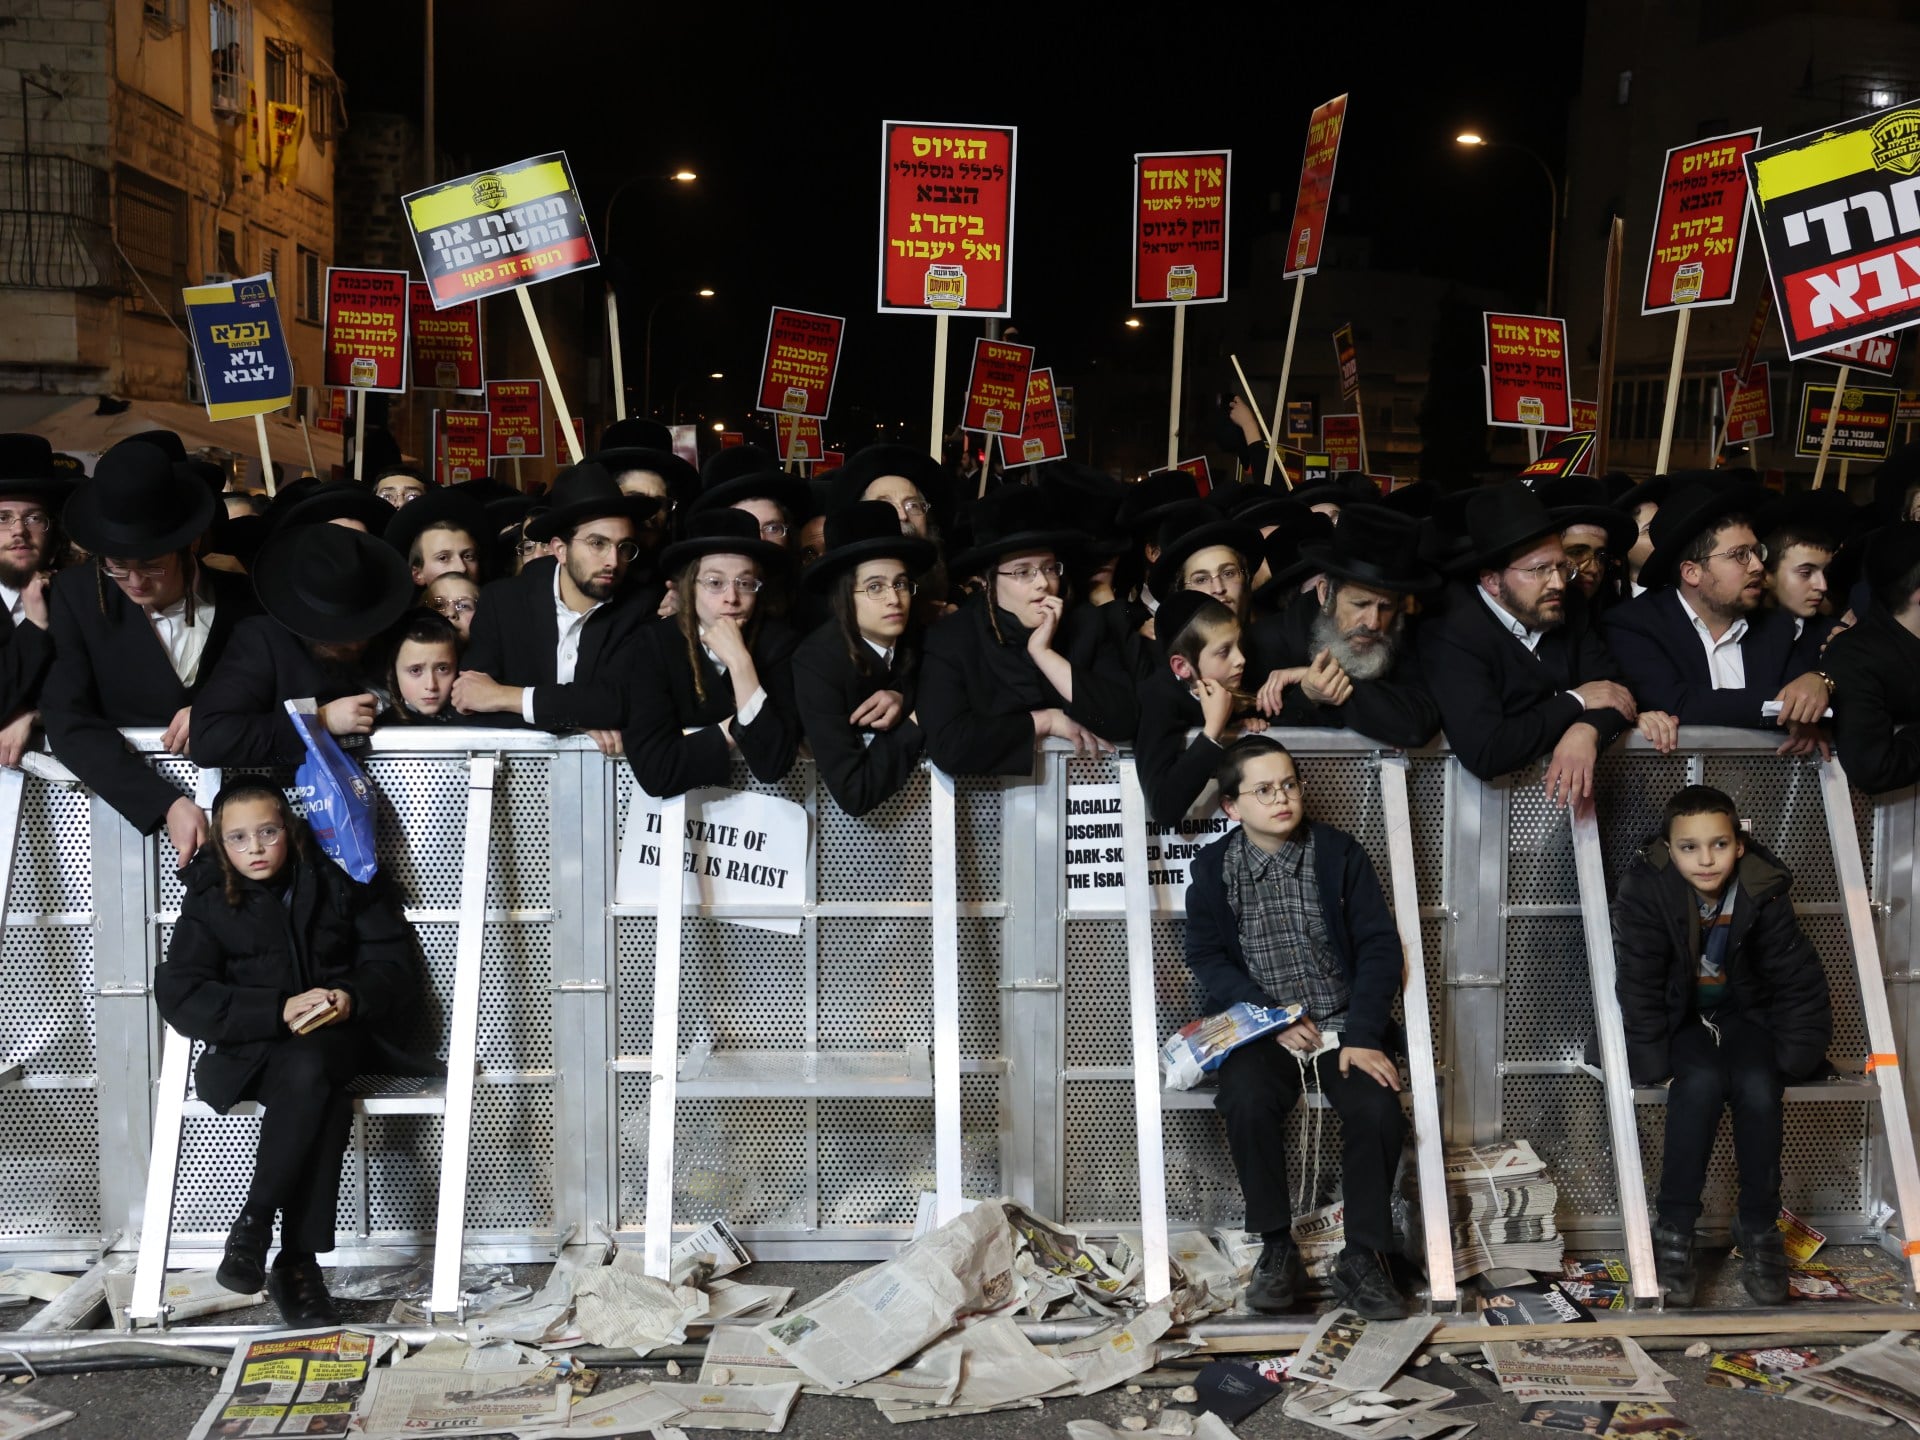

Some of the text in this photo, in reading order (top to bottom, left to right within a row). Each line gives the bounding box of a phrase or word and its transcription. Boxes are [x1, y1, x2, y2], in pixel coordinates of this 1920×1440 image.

[912, 136, 987, 160] הגיוס
[1682, 147, 1736, 174] הגיוס
[894, 160, 1004, 181] לכלל מסלולי
[1712, 169, 1745, 184] לכלל
[1144, 167, 1222, 193] אין אחד
[917, 184, 979, 204] הצבא
[1143, 194, 1220, 211] שיכול לאשר
[1679, 189, 1724, 213] הצבא
[478, 196, 568, 237] תחזירו
[910, 212, 985, 236] ביהרג
[430, 222, 474, 251] את
[1142, 217, 1220, 239] חוק לגיוס
[1670, 215, 1724, 241] ביהרג
[441, 218, 570, 270] החטופים!
[891, 238, 1001, 262] ואל יעבור
[1656, 237, 1734, 264] ואל יעבור
[461, 249, 563, 288] רוסיה זה כאן!
[337, 276, 394, 290] הסכמה
[337, 310, 395, 327] הסכמה
[419, 319, 470, 333] הסכמה
[215, 321, 267, 341] לכלא
[333, 327, 398, 342] להחרבת
[1492, 322, 1560, 346] אין אחד
[230, 349, 264, 366] ולא
[334, 342, 396, 358] היהדות
[778, 344, 828, 363] הסכמה
[988, 346, 1021, 362] הגיוס
[1493, 344, 1560, 359] שיכול לאשר
[1865, 339, 1892, 365] או
[223, 364, 275, 383] לצבא
[771, 359, 829, 377] להחרבת
[771, 372, 825, 390] היהדות
[497, 385, 530, 396] הגיוס
[982, 383, 1015, 398] ביהרג
[972, 394, 1021, 411] ואל יעבור
[446, 415, 479, 426] הגיוס
[1860, 414, 1886, 425] עברנו
[492, 426, 519, 436] יעבור
[521, 426, 538, 436] ואל
[1850, 430, 1874, 439] נעבור
[1847, 438, 1886, 449] המשטרה
[468, 457, 485, 467] ואל
[685, 819, 739, 847] STATE
[743, 830, 768, 852] OF
[1174, 818, 1228, 835] AGAINST
[1165, 843, 1200, 860] JEWS
[704, 855, 722, 877] IS
[725, 860, 788, 889] RACIST
[1066, 873, 1090, 889] THE
[1149, 869, 1184, 885] STATE
